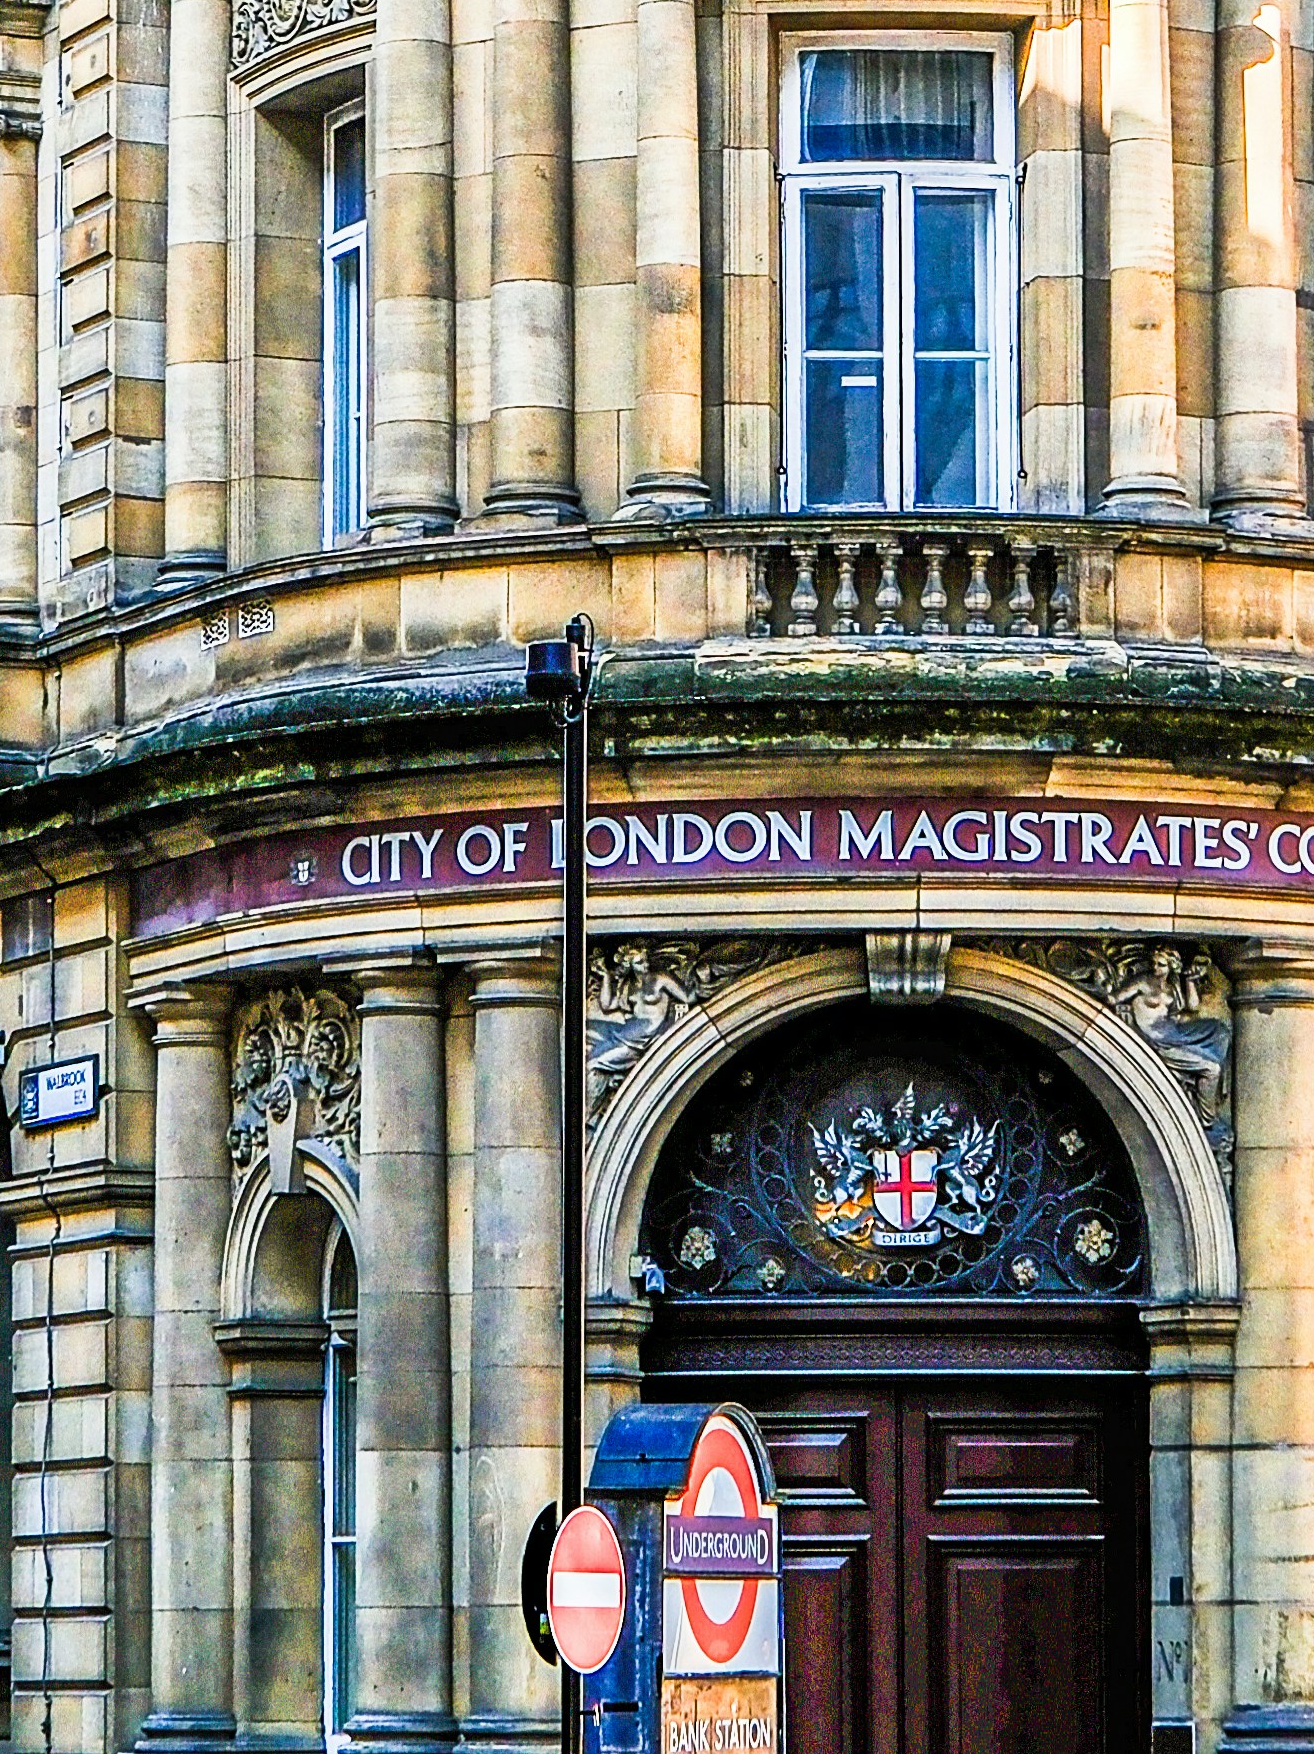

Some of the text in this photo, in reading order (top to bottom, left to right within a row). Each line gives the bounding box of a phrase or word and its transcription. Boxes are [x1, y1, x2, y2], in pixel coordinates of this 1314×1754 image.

[341, 828, 444, 886] CITY
[456, 822, 529, 876] OF
[551, 810, 812, 869] LONDON
[838, 809, 1259, 871] MAGISTRATES'
[46, 1068, 86, 1091] WALBROOK
[882, 1233, 930, 1244] DIRIGE
[670, 1525, 769, 1565] UNDERGROUND
[669, 1717, 771, 1753] BANK STATION
